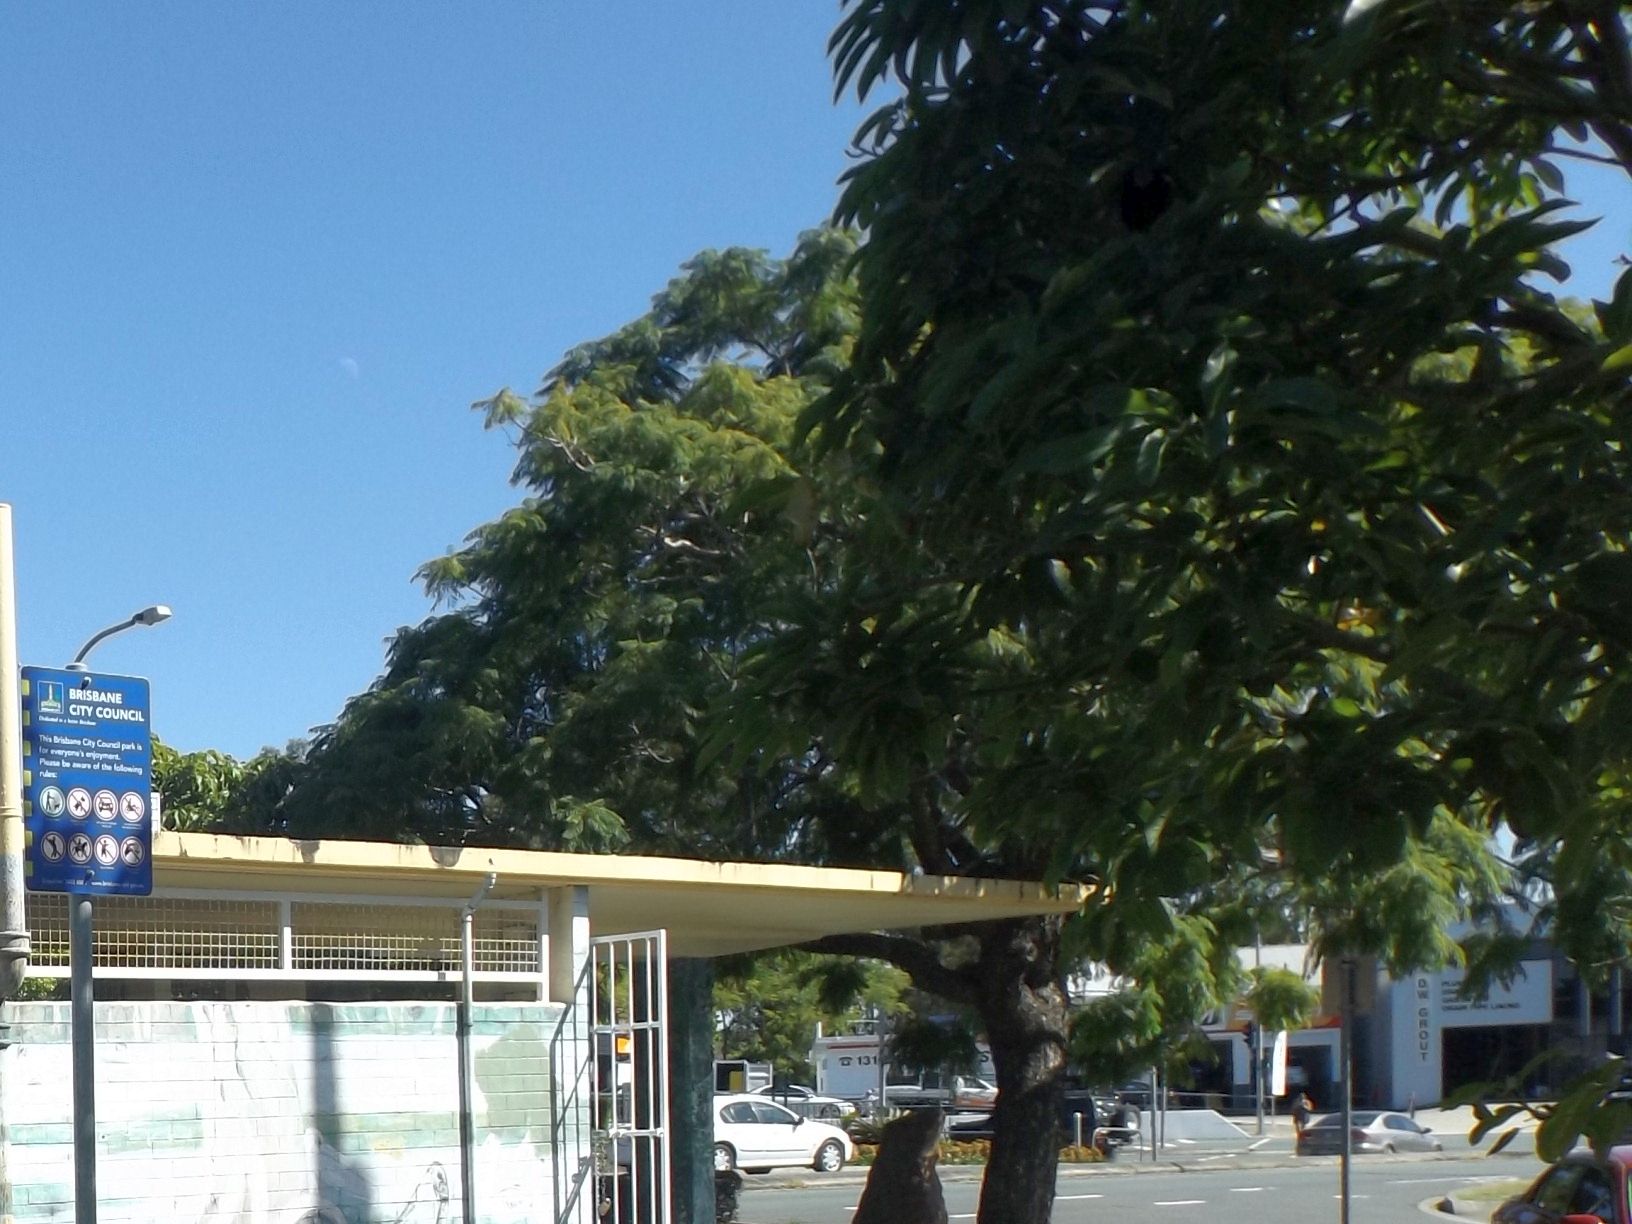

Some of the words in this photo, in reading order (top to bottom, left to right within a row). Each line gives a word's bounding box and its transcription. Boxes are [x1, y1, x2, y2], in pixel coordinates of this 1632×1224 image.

[69, 688, 122, 704] BRISBANE
[69, 704, 93, 717] CITY
[96, 707, 144, 721] COUNCIL
[39, 734, 52, 743] This
[53, 735, 81, 746] Brisbane
[82, 738, 96, 748] City
[97, 740, 120, 749] Council
[121, 743, 136, 751] park
[136, 743, 143, 751] is
[39, 746, 48, 754] for
[50, 749, 85, 758] everyone's
[86, 751, 121, 761] enjoyment.
[39, 758, 61, 767] Please
[61, 759, 71, 768] be
[93, 762, 100, 770] of
[101, 763, 112, 771] the
[113, 763, 143, 775] following
[39, 770, 58, 778] rules:
[1419, 1008, 1428, 1061] GROUT
